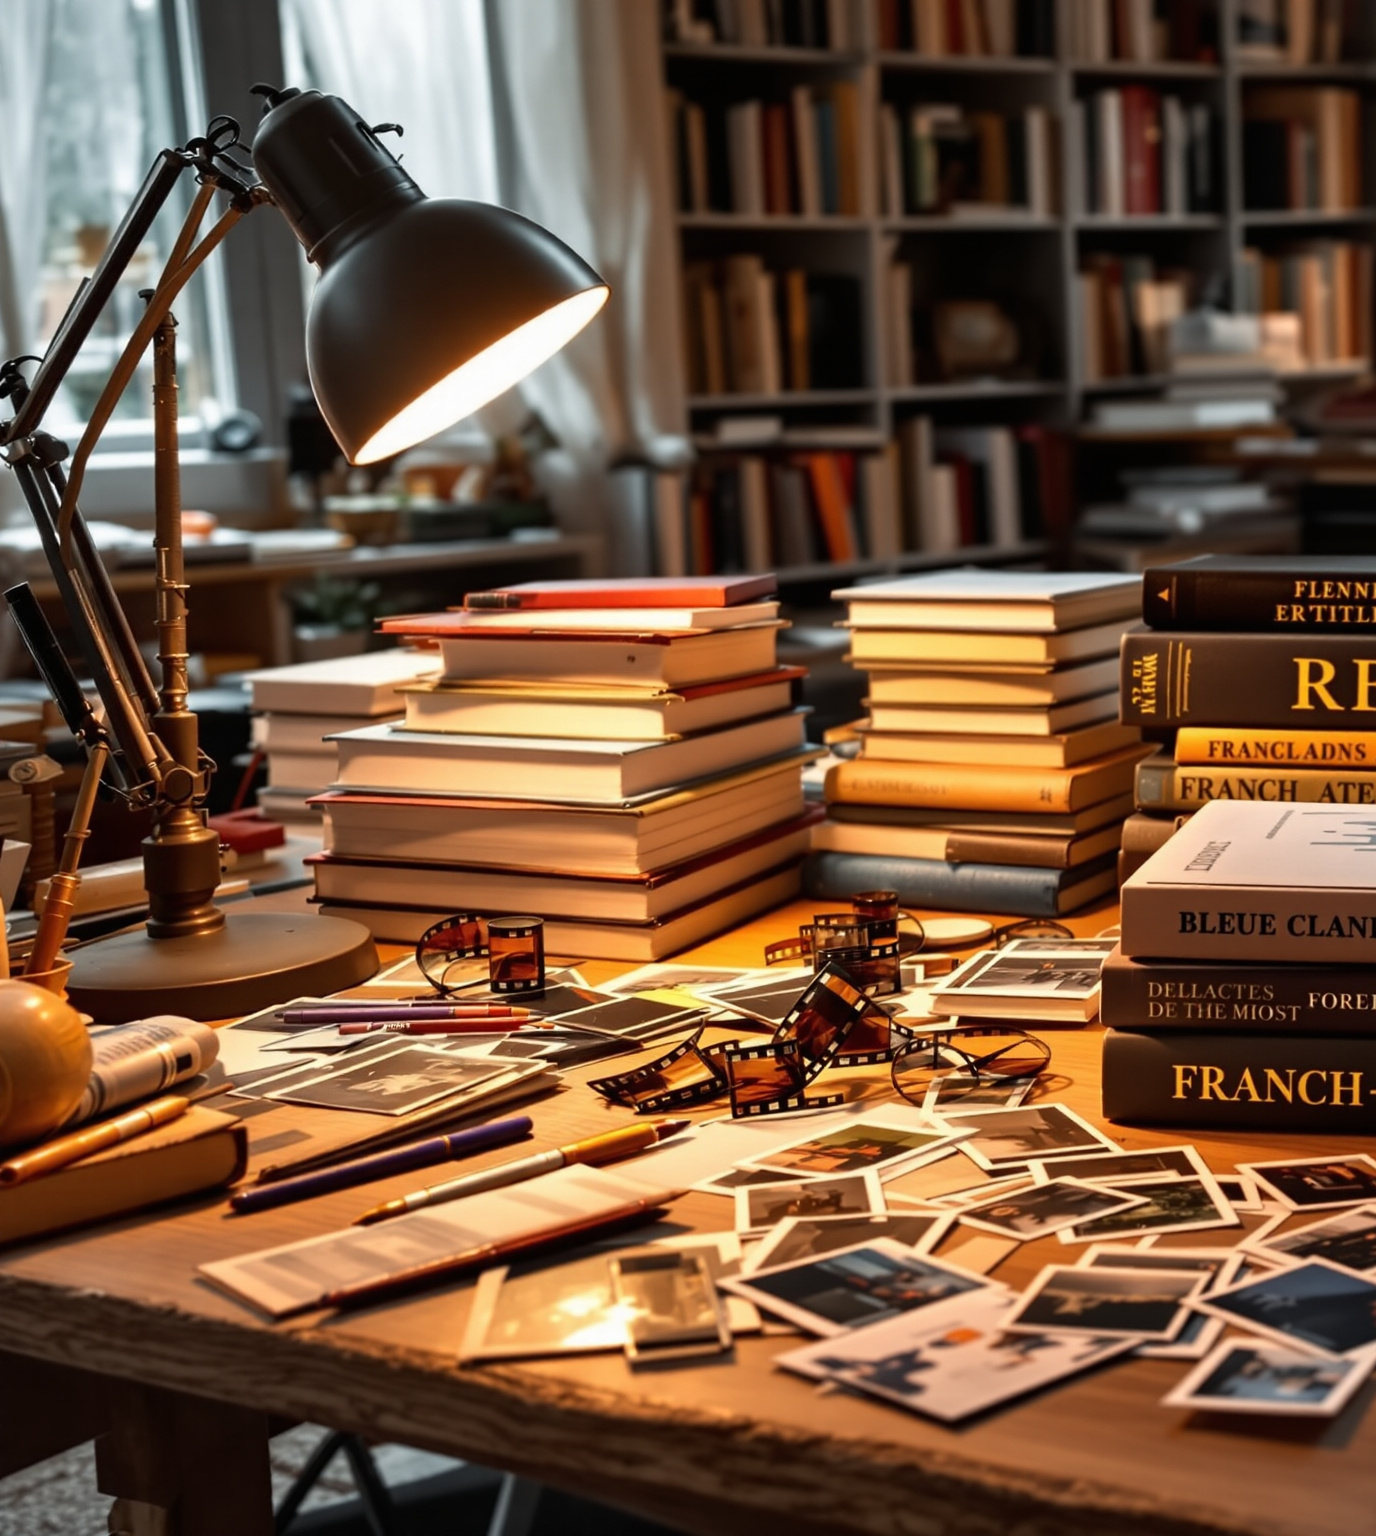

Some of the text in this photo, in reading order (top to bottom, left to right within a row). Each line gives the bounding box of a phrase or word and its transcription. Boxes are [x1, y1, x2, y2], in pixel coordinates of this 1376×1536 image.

[1180, 776, 1299, 802] FRANCH
[1316, 781, 1376, 804] ATE
[1178, 911, 1277, 937] BLEUE
[1147, 981, 1275, 1001] DELLACTES
[1147, 1001, 1302, 1022] DE THE MIOST
